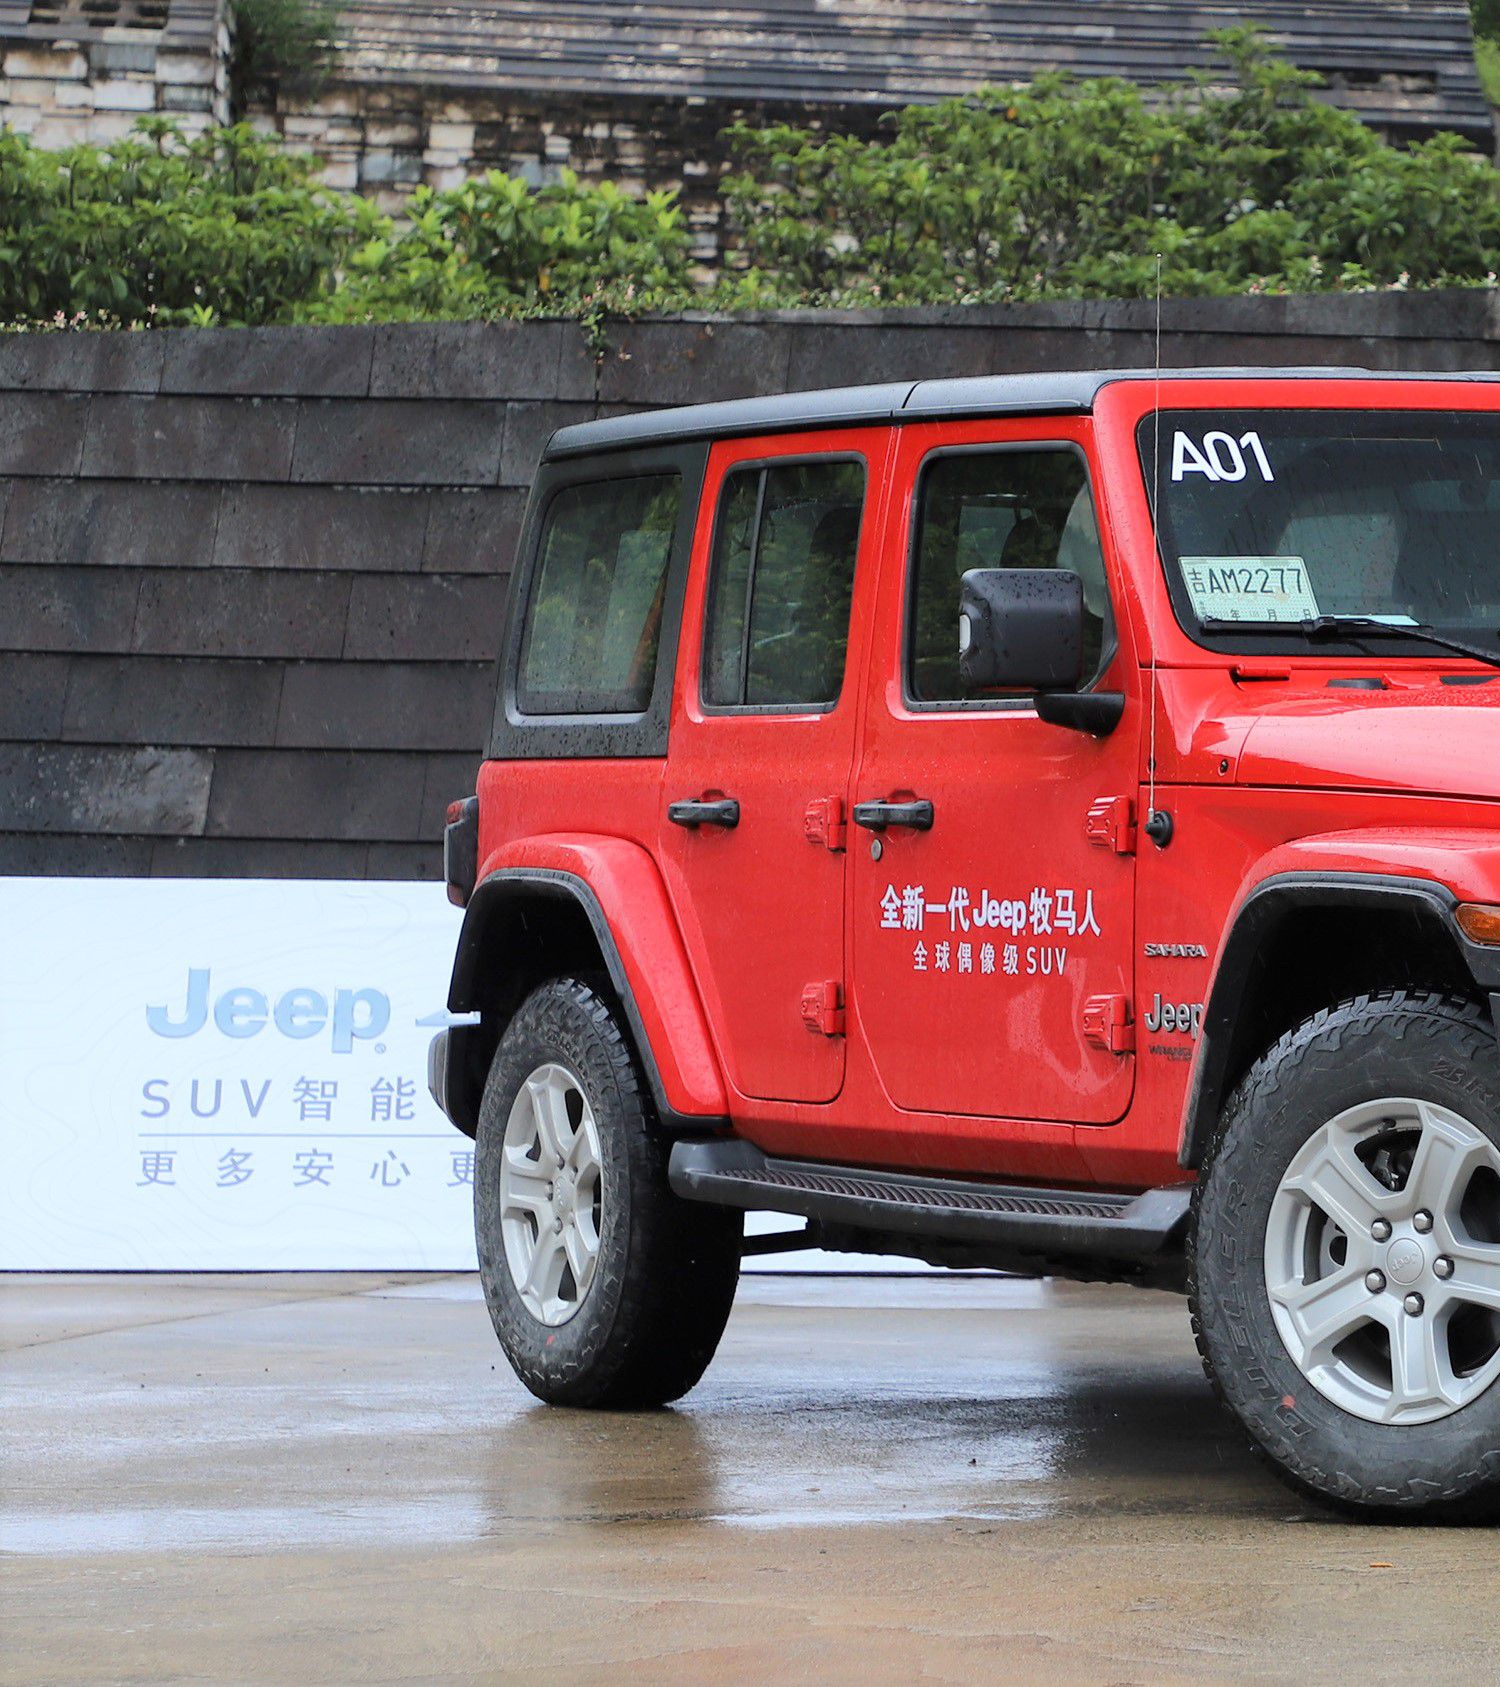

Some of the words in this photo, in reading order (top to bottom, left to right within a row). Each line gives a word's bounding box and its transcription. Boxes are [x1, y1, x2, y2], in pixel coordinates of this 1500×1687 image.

[1171, 431, 1275, 482] A01
[1144, 943, 1208, 958] SAHARA
[146, 967, 391, 1054] Jeep
